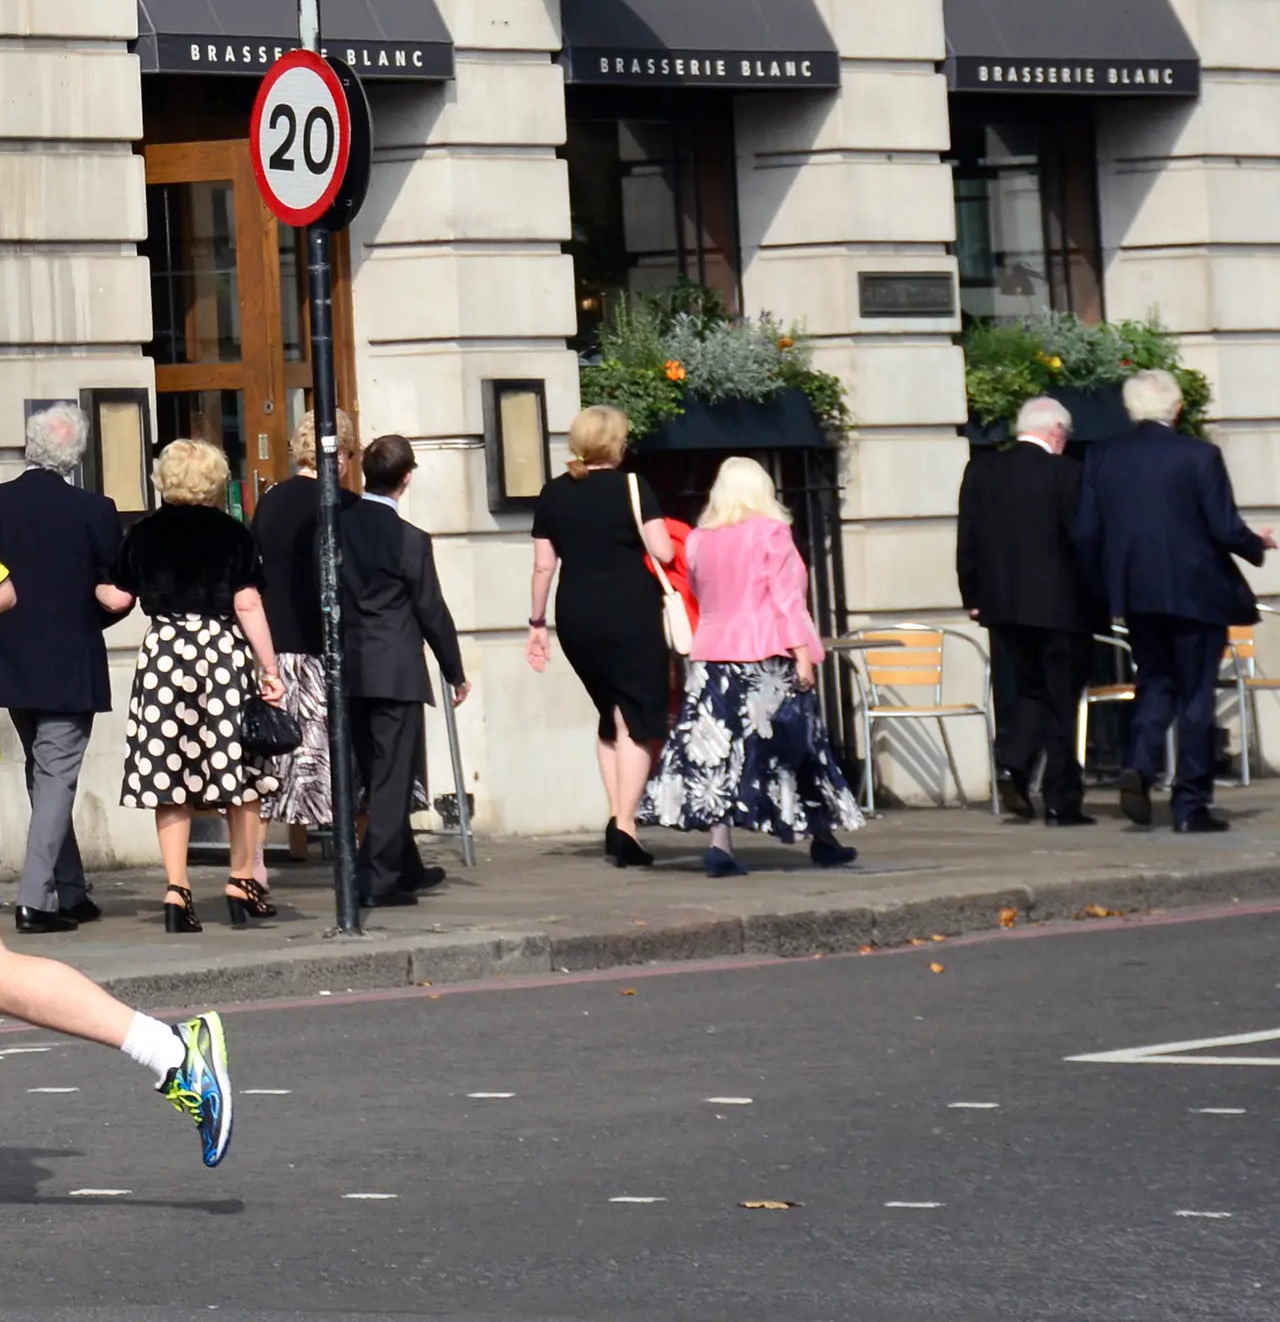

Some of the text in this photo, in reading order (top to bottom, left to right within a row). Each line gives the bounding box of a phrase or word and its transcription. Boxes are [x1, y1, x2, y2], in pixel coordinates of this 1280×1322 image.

[346, 49, 424, 67] BLANC
[600, 57, 812, 77] BRASSERIE BLANC
[978, 66, 1174, 84] BRASSERIE BLANC
[269, 103, 335, 175] 20
